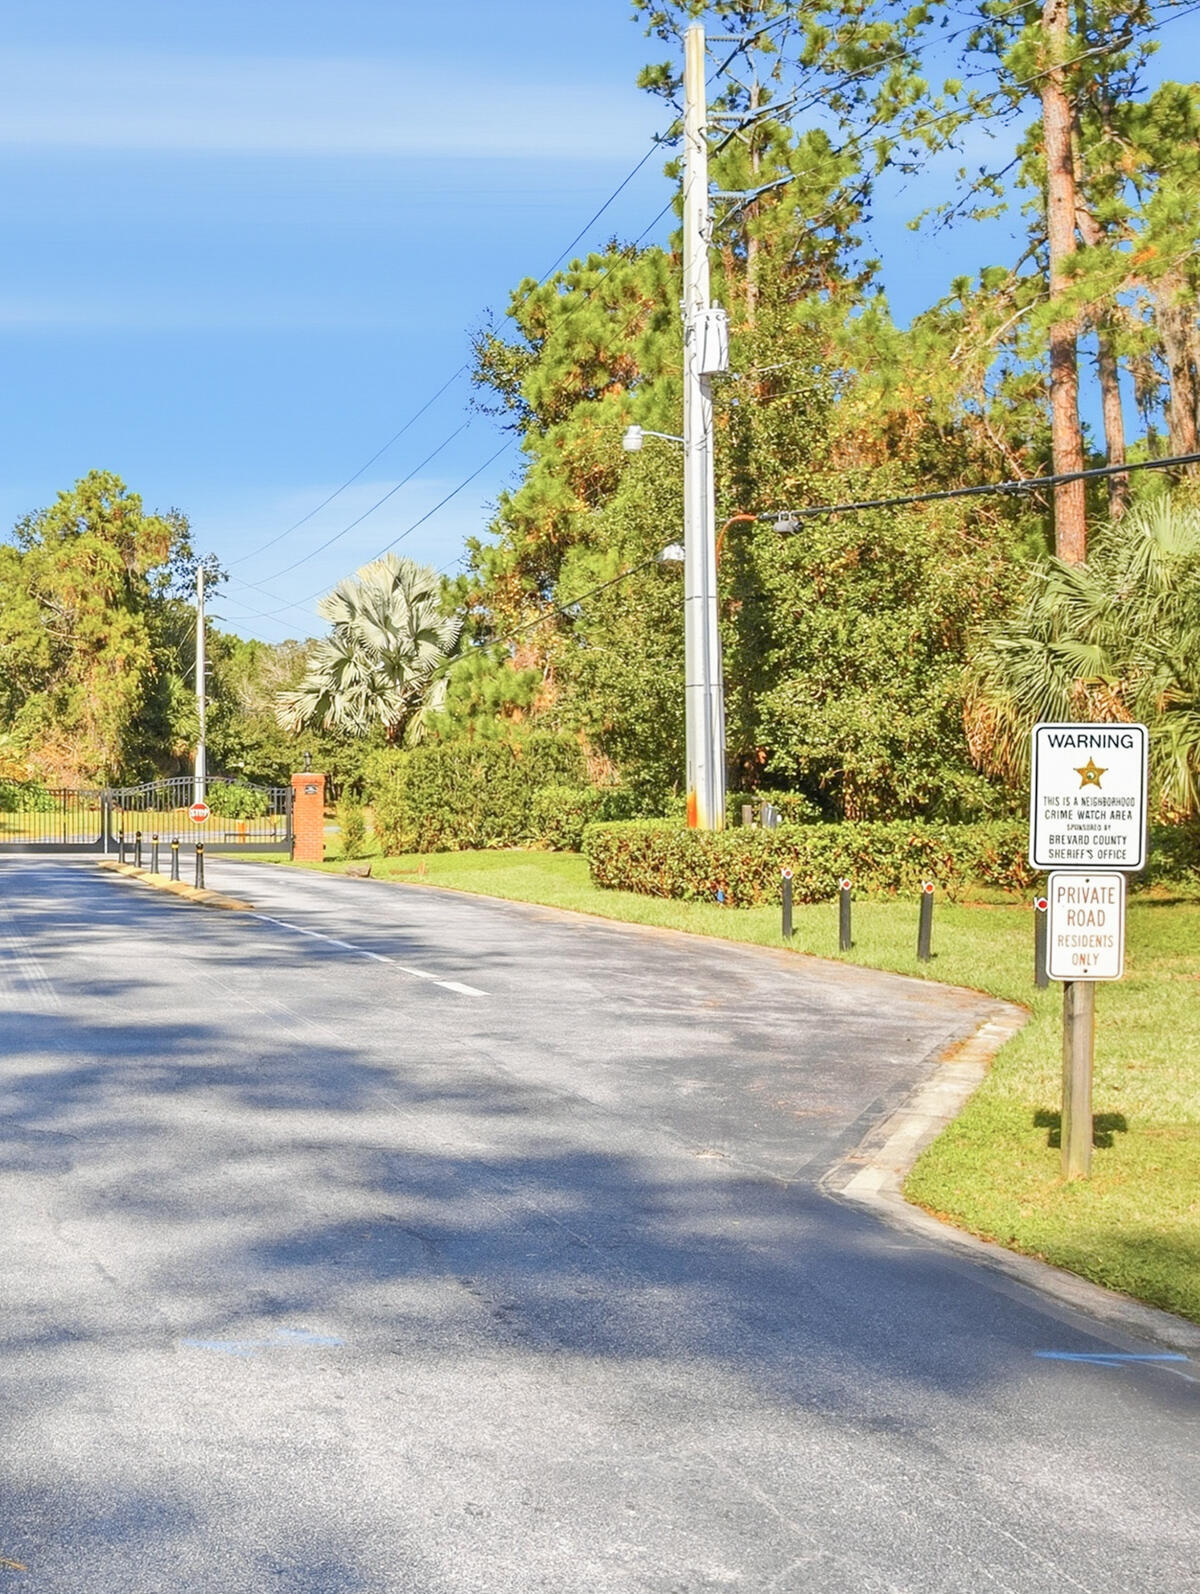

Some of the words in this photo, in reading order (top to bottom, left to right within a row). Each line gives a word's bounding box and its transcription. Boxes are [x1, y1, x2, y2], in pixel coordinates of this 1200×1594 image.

[1047, 734, 1134, 749] WARNING
[1043, 796, 1060, 806] THIS
[1062, 796, 1071, 806] IS
[1073, 796, 1079, 806] A
[1081, 796, 1135, 807] NEIGHBORHOOD
[190, 808, 208, 817] STOP
[1044, 809, 1073, 820] CRIME
[1077, 810, 1106, 820] WATCH
[1109, 810, 1133, 821] AREA
[1048, 834, 1090, 845] BREVARD
[1093, 835, 1127, 845] COUNTY
[1048, 848, 1094, 860] SHERIFF'S
[1097, 849, 1127, 860] OFFICE
[1057, 886, 1116, 904] PRIVATE
[1067, 909, 1105, 927] ROAD
[1057, 934, 1114, 948] RESIDENTS
[1071, 953, 1099, 966] ONLY
